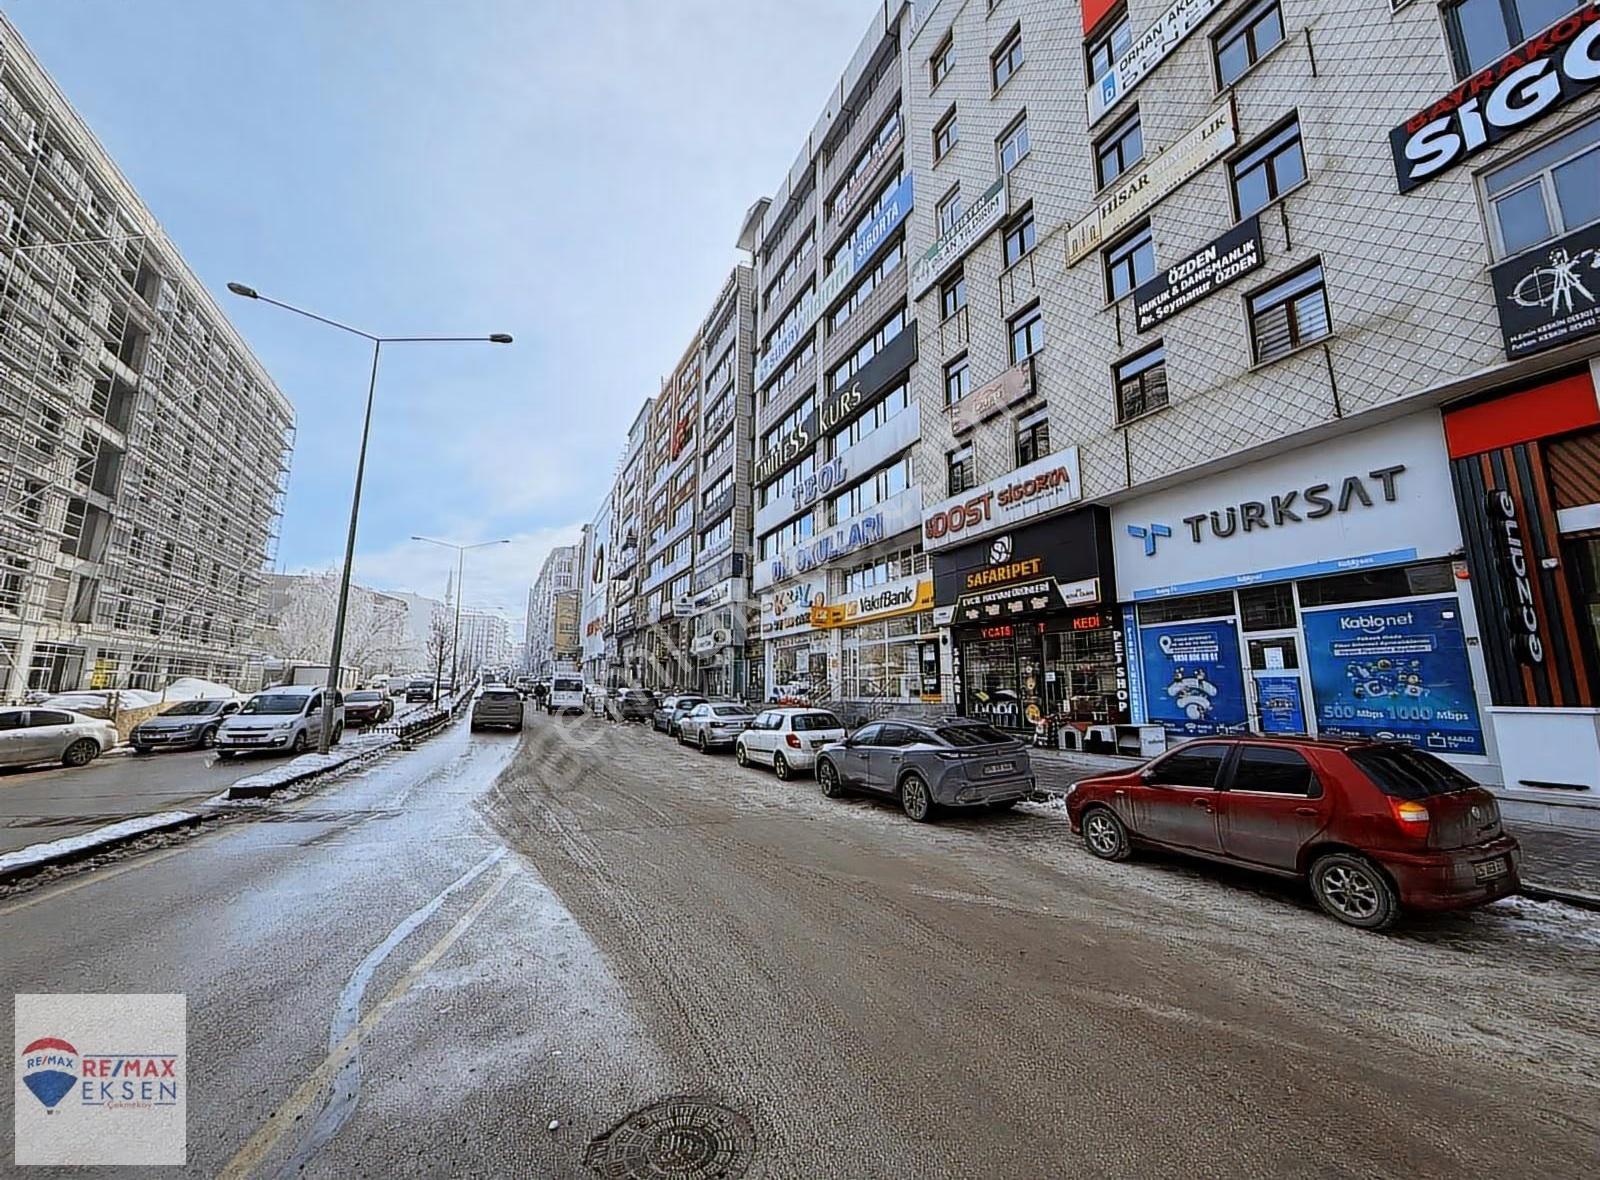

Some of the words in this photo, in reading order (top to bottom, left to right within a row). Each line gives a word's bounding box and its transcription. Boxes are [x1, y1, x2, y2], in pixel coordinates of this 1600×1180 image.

[1120, 22, 1163, 72] ORHAN
[1102, 174, 1150, 219] HİSAR
[1168, 245, 1217, 285] ÖZDEN
[1216, 253, 1257, 284] ÖZDEN
[1138, 289, 1170, 316] HUKUK
[818, 381, 862, 436] KURS
[1182, 464, 1407, 544] TÜRKSAT
[1116, 667, 1128, 712] SHOP
[1324, 705, 1354, 719] 500
[1356, 709, 1384, 719] Mbps
[1387, 706, 1433, 720] 1000
[1436, 710, 1469, 722] Mbps
